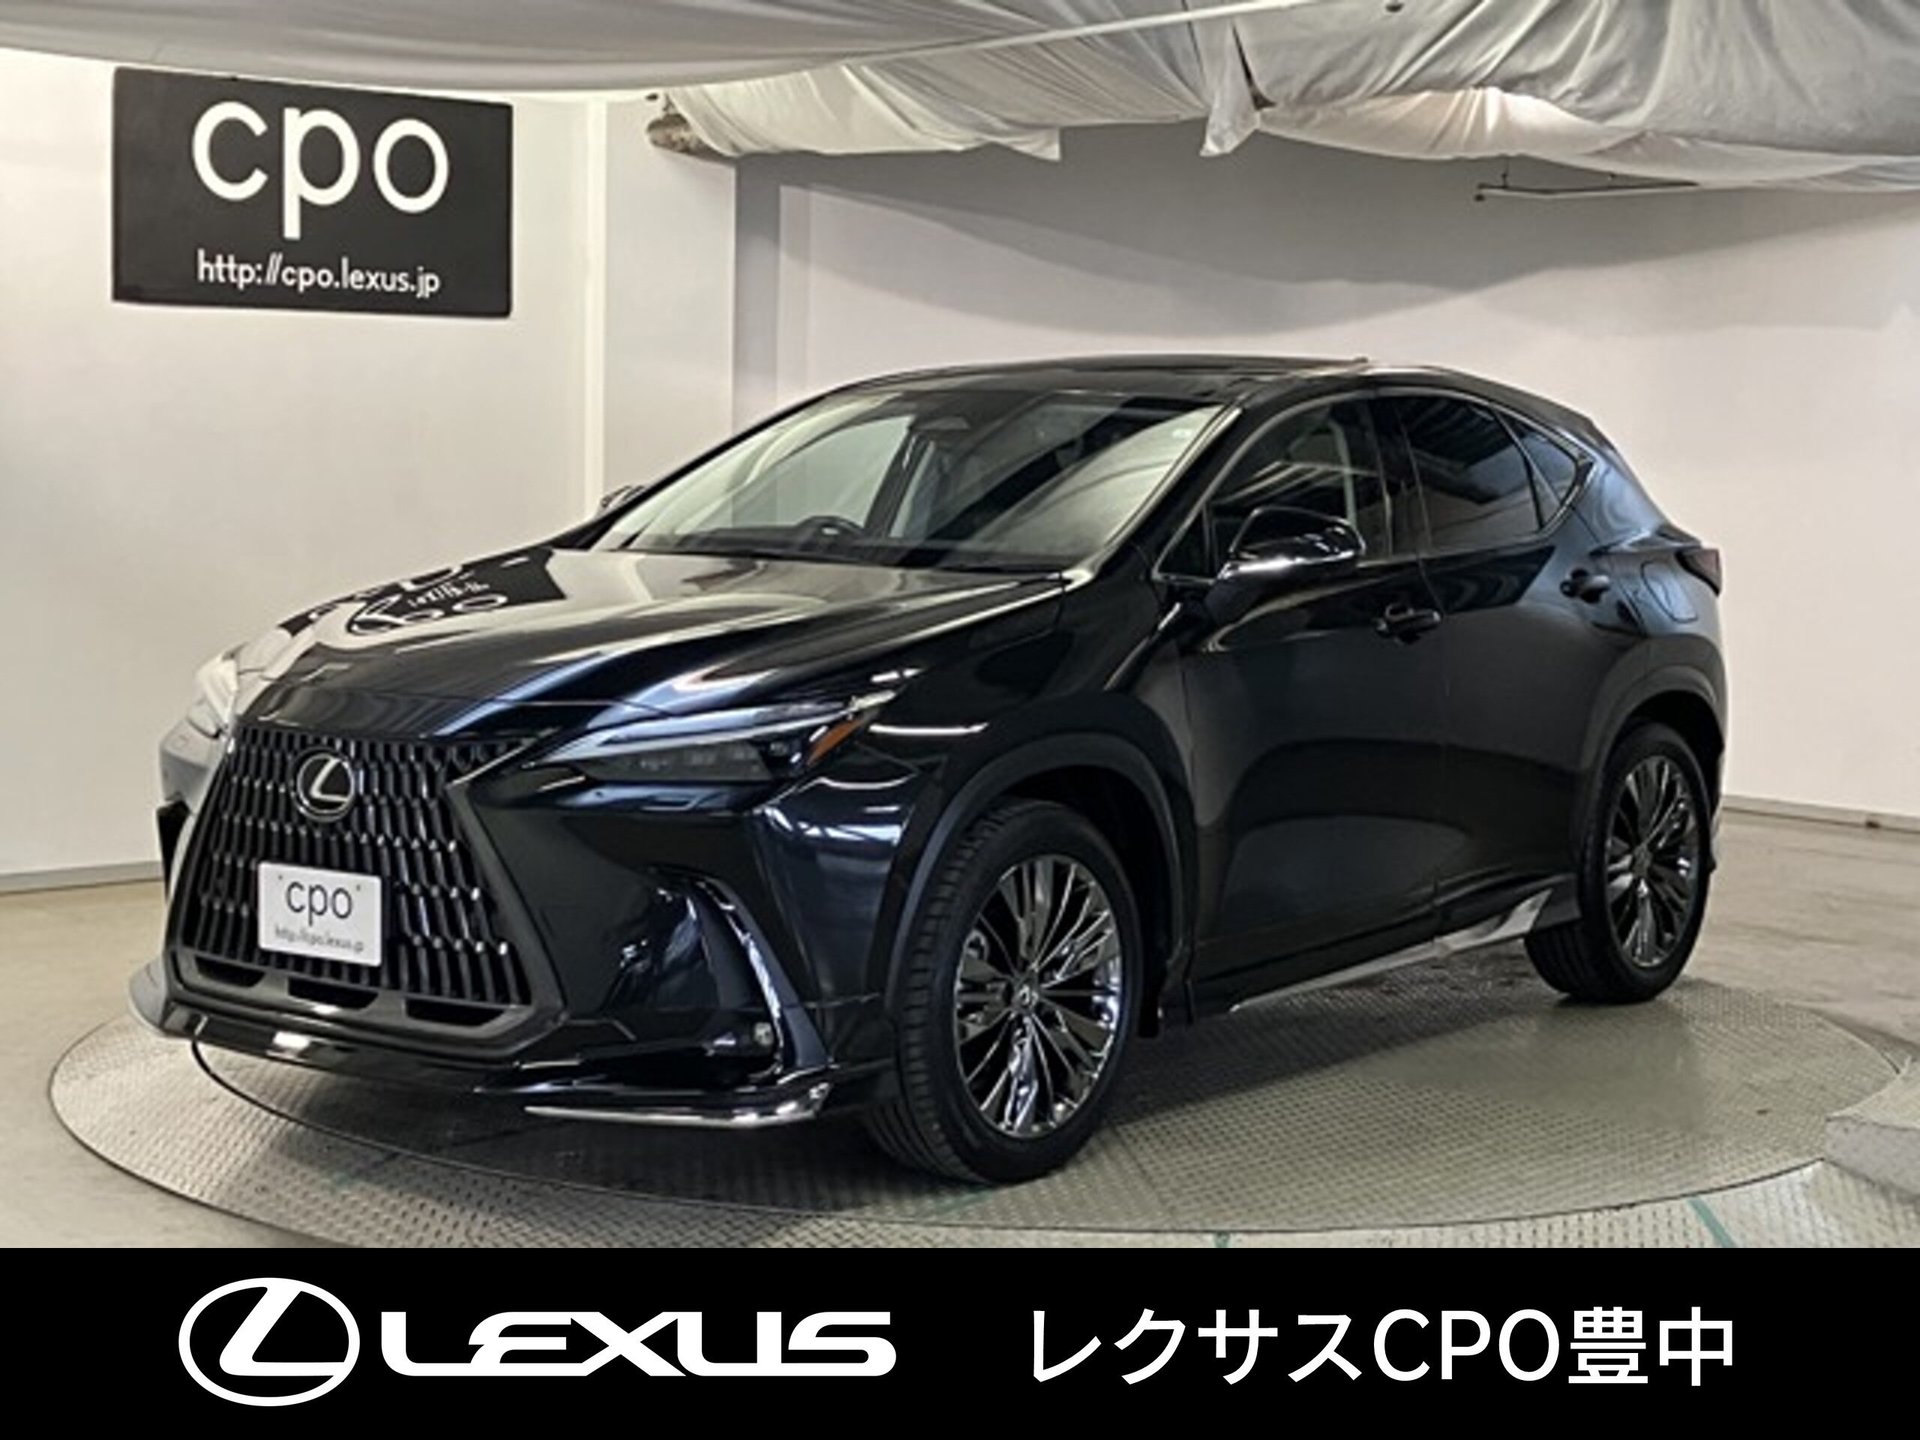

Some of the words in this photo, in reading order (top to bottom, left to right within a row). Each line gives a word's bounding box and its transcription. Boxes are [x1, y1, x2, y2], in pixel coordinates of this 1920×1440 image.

[192, 101, 449, 239] cpo
[198, 249, 440, 297] http://cpo.lexus.jp
[286, 882, 353, 926] cpo
